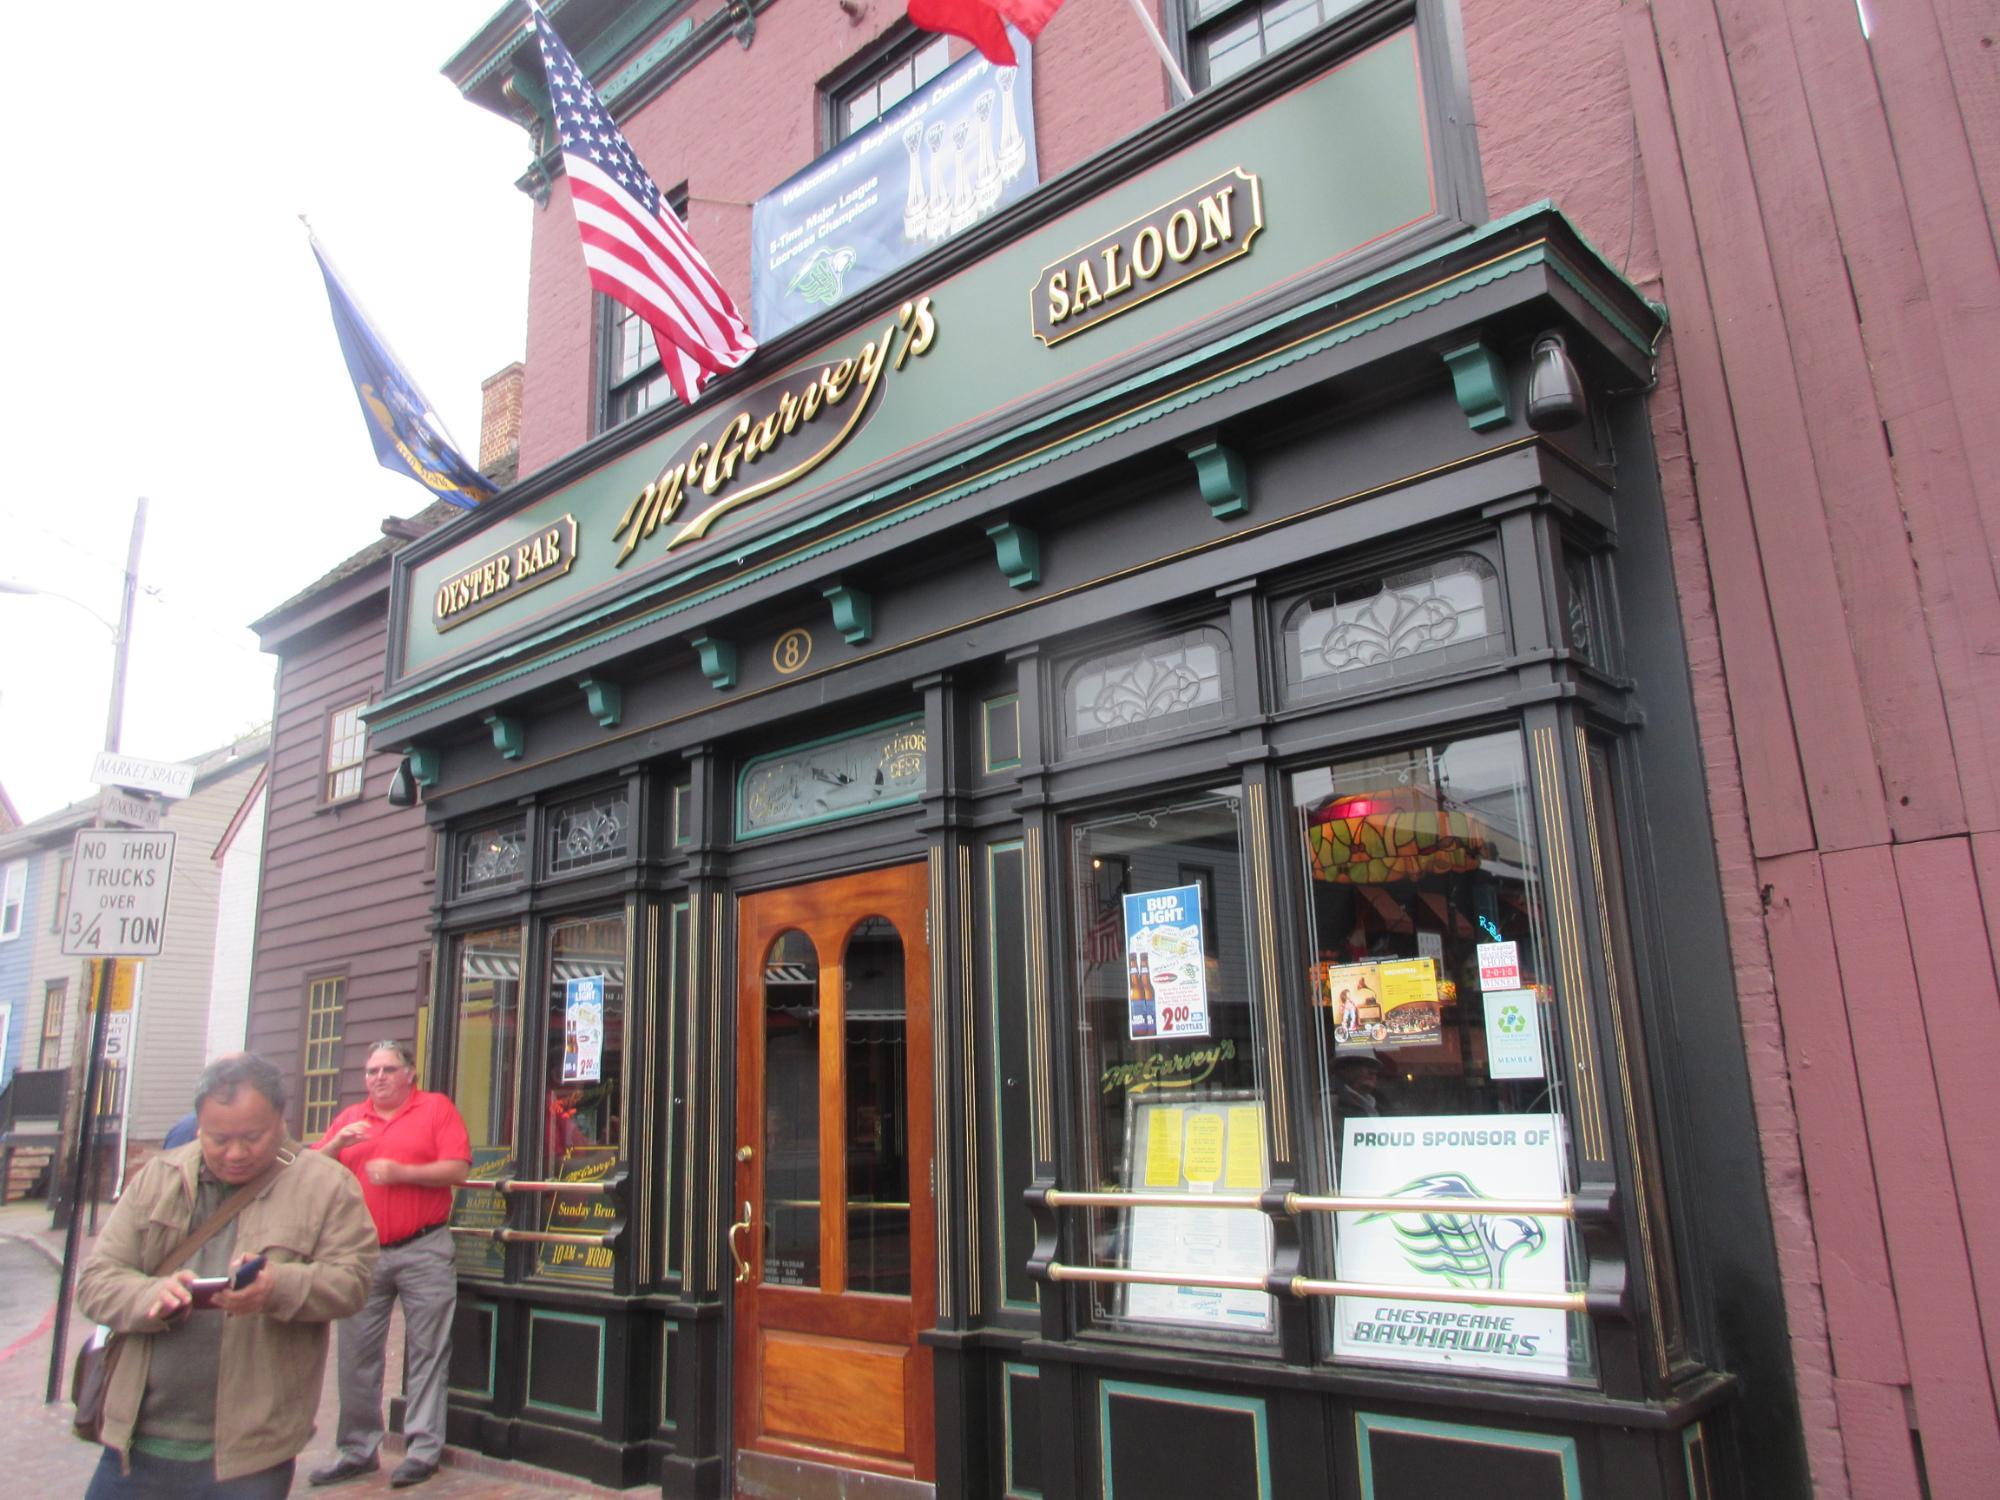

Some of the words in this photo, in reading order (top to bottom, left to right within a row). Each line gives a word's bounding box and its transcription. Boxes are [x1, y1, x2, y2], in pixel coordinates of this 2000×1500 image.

[782, 161, 838, 206] Welcome
[842, 150, 857, 166] to
[769, 224, 804, 254] 5-Time
[806, 203, 837, 230] Major
[839, 176, 878, 207] League
[769, 234, 816, 271] Lacrosse
[818, 192, 879, 240] Champions
[1048, 185, 1234, 324] SALOON
[611, 295, 936, 569] McGarvey's
[437, 555, 511, 619] OYSTER
[515, 529, 561, 581] BAR
[785, 636, 799, 668] 8
[97, 758, 148, 781] MARKET
[148, 766, 190, 786] SPACE
[83, 842, 107, 860] NO
[122, 842, 167, 860] THRU
[87, 868, 156, 887] TRUCKS
[99, 894, 136, 909] OVER
[1146, 895, 1178, 912] BUD
[1141, 906, 1185, 925] LIGHT
[119, 916, 160, 944] TON
[575, 990, 596, 1002] LIGHT
[578, 981, 594, 992] BUD
[1175, 1023, 1204, 1031] BOTTLES
[107, 1037, 121, 1054] 5
[1498, 1056, 1534, 1064] MEMBER
[1353, 1132, 1415, 1147] PROUD
[1422, 1130, 1517, 1146] SPONSOR
[1524, 1130, 1550, 1145] OF
[558, 1202, 592, 1219] Sunday
[594, 1202, 616, 1218] Bru
[552, 1245, 577, 1265] 10AM
[585, 1246, 614, 1268] NOON
[1374, 1307, 1515, 1332] CHESAPEAKE
[1352, 1321, 1541, 1357] BAYHAWKS
